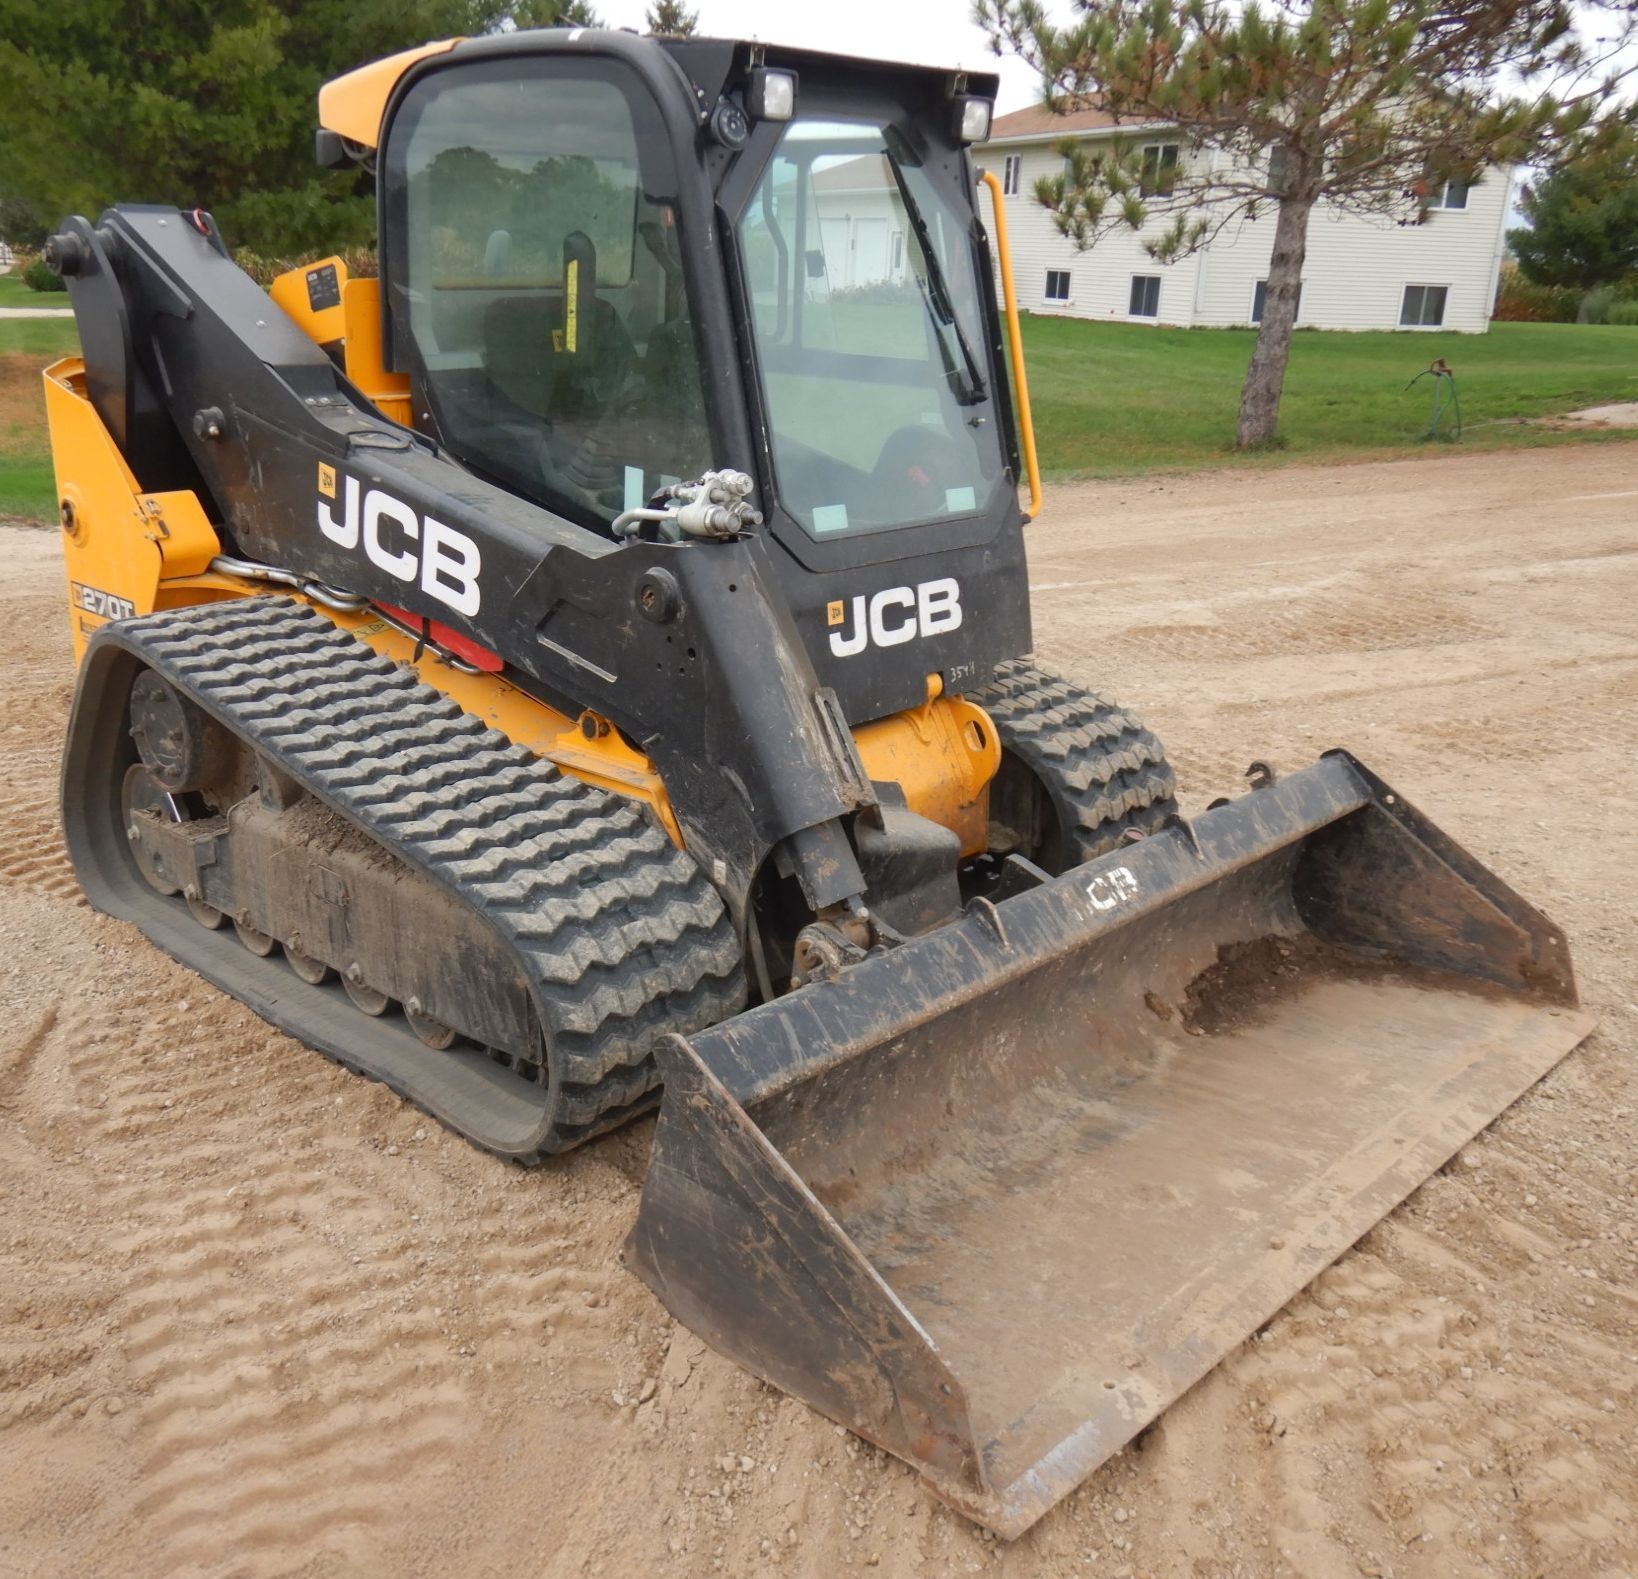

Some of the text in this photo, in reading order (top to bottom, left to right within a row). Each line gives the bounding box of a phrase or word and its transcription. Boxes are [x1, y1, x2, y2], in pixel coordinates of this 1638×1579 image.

[318, 475, 481, 616] JCB
[82, 587, 133, 620] 270T
[829, 578, 962, 657] JCB
